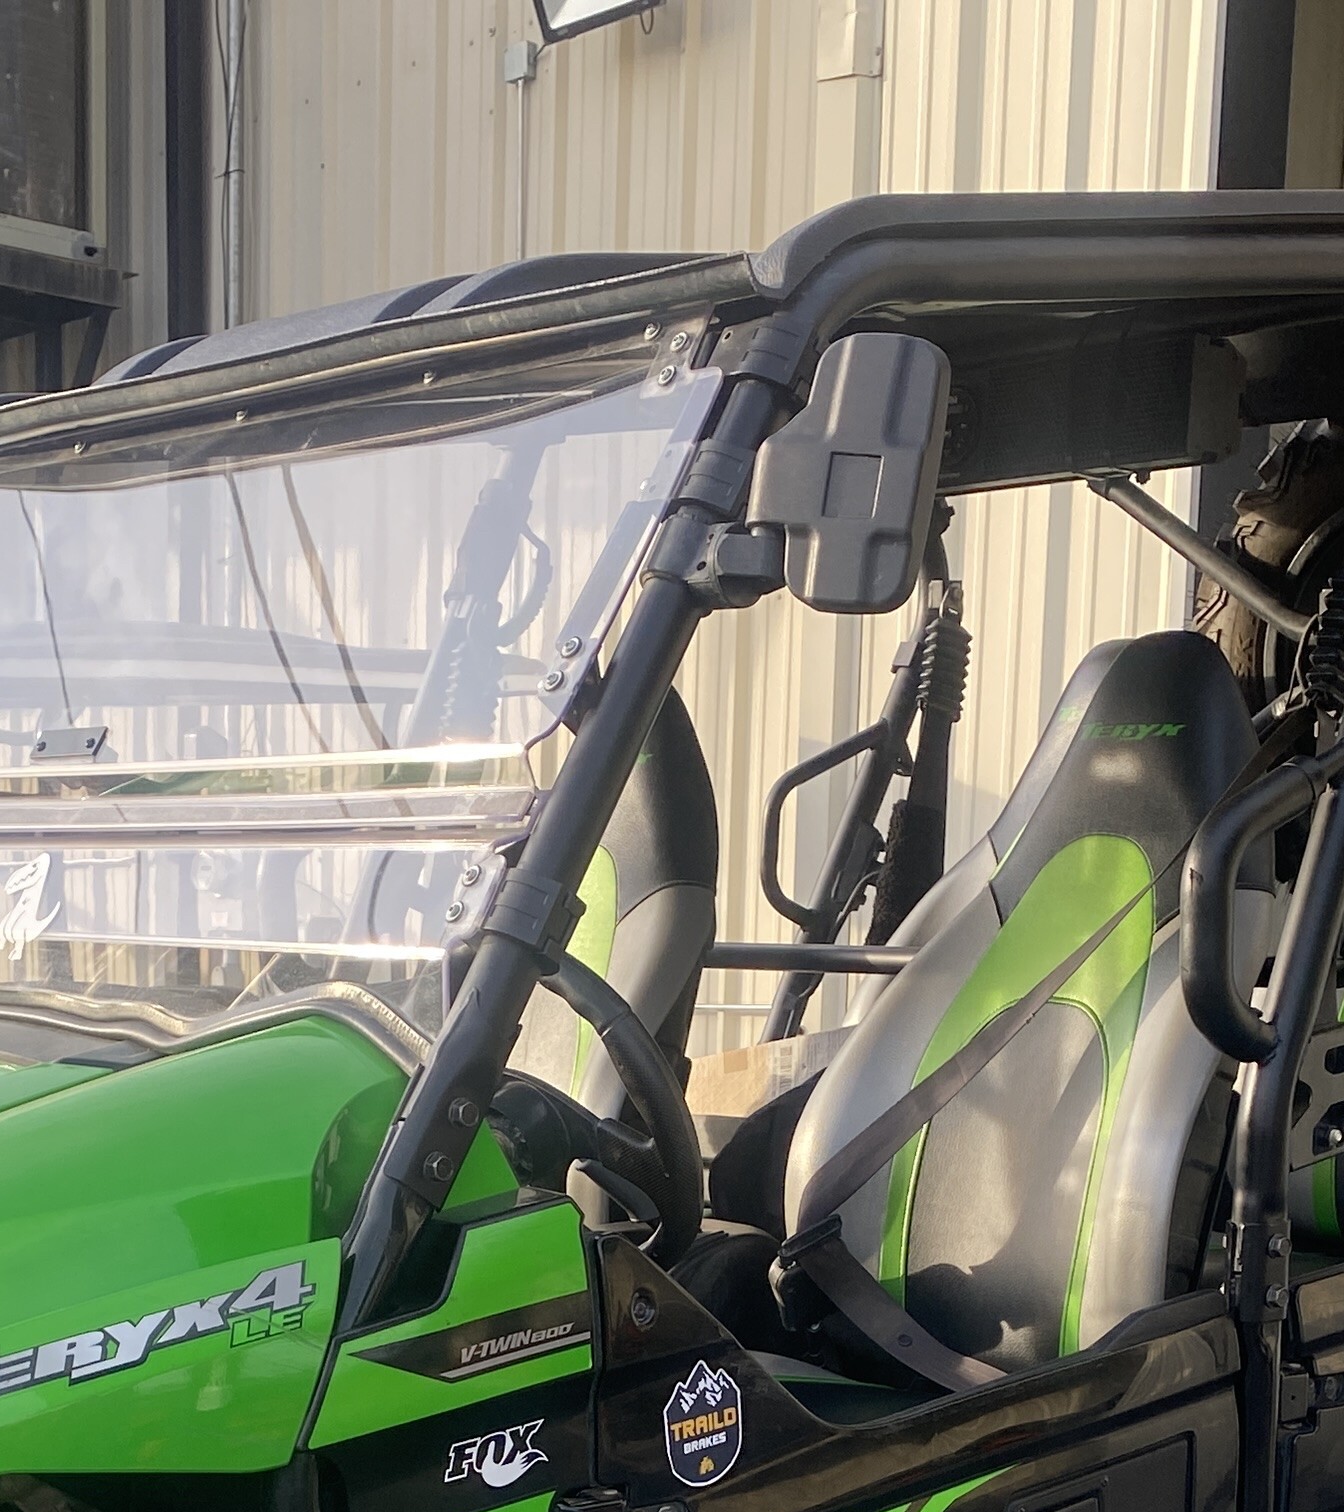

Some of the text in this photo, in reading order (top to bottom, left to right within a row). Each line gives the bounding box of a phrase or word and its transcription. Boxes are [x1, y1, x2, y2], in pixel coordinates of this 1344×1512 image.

[229, 1301, 313, 1348] LE
[670, 1406, 737, 1442] TRAILD
[683, 1431, 727, 1455] BRAKES
[444, 1418, 549, 1487] FOX
